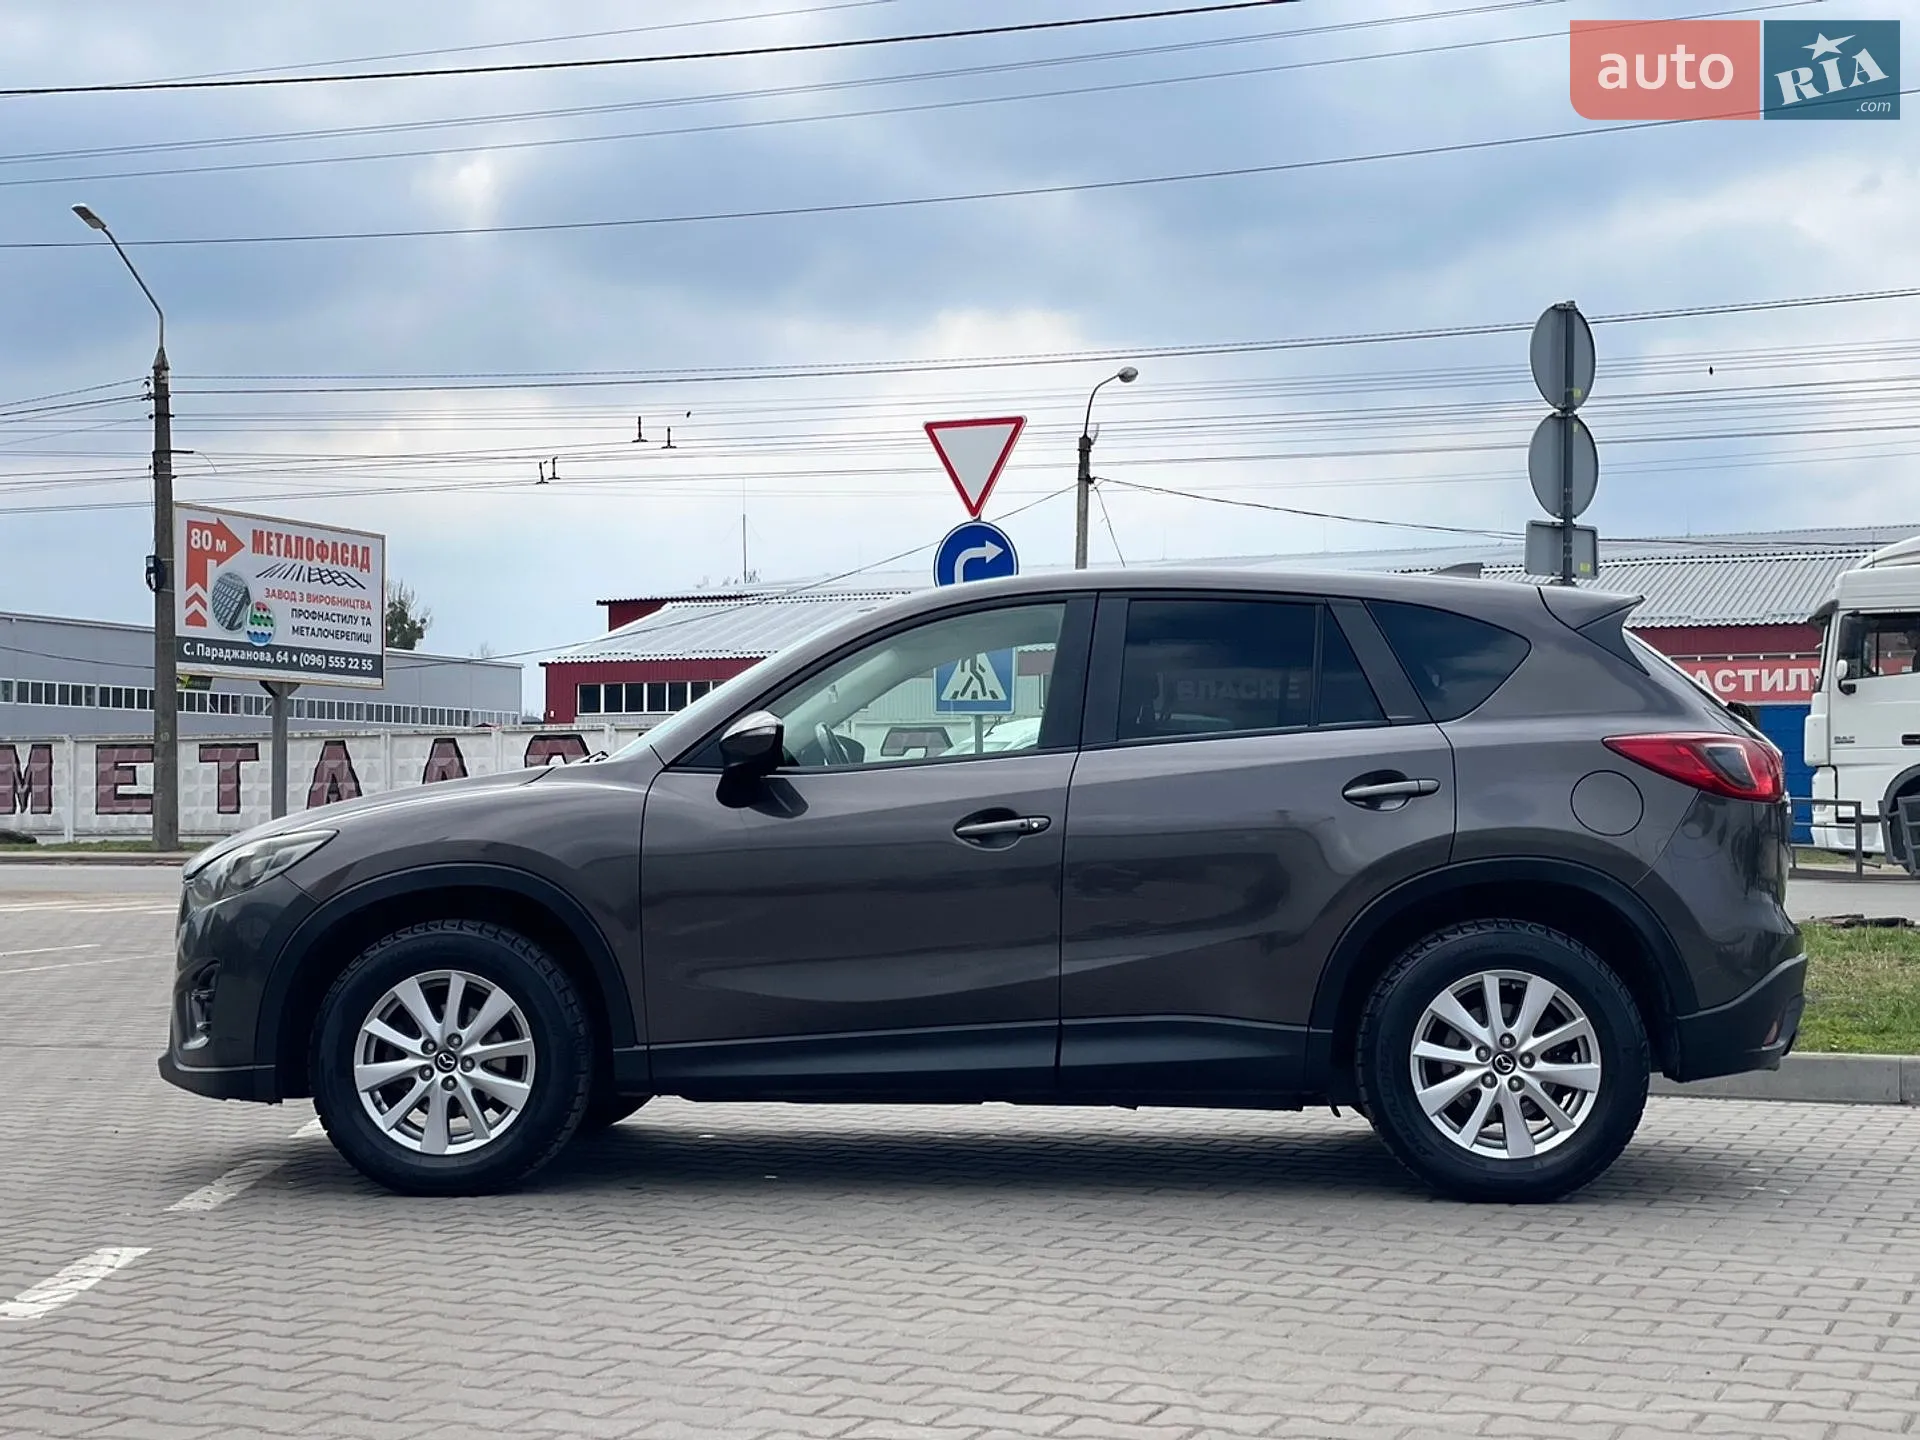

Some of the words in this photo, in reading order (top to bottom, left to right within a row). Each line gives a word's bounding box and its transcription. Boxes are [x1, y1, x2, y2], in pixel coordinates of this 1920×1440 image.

[190, 528, 212, 551] 80
[252, 529, 371, 573] МЕТАЛОФАСАД
[264, 587, 297, 602] ЗАВОД
[306, 593, 371, 611] ВИРОБНИЦТВА
[291, 608, 358, 625] ПРОФНАСТИЛУ
[361, 616, 371, 627] ТА
[291, 626, 371, 643] МЕТАЛОЧЕРЕПИЦІ
[183, 642, 194, 656] С.
[197, 643, 275, 664] Параджанова,
[276, 652, 288, 662] 64
[300, 654, 326, 669] (096)
[328, 655, 346, 668] 555
[348, 657, 359, 669] 22
[361, 658, 373, 671] 55
